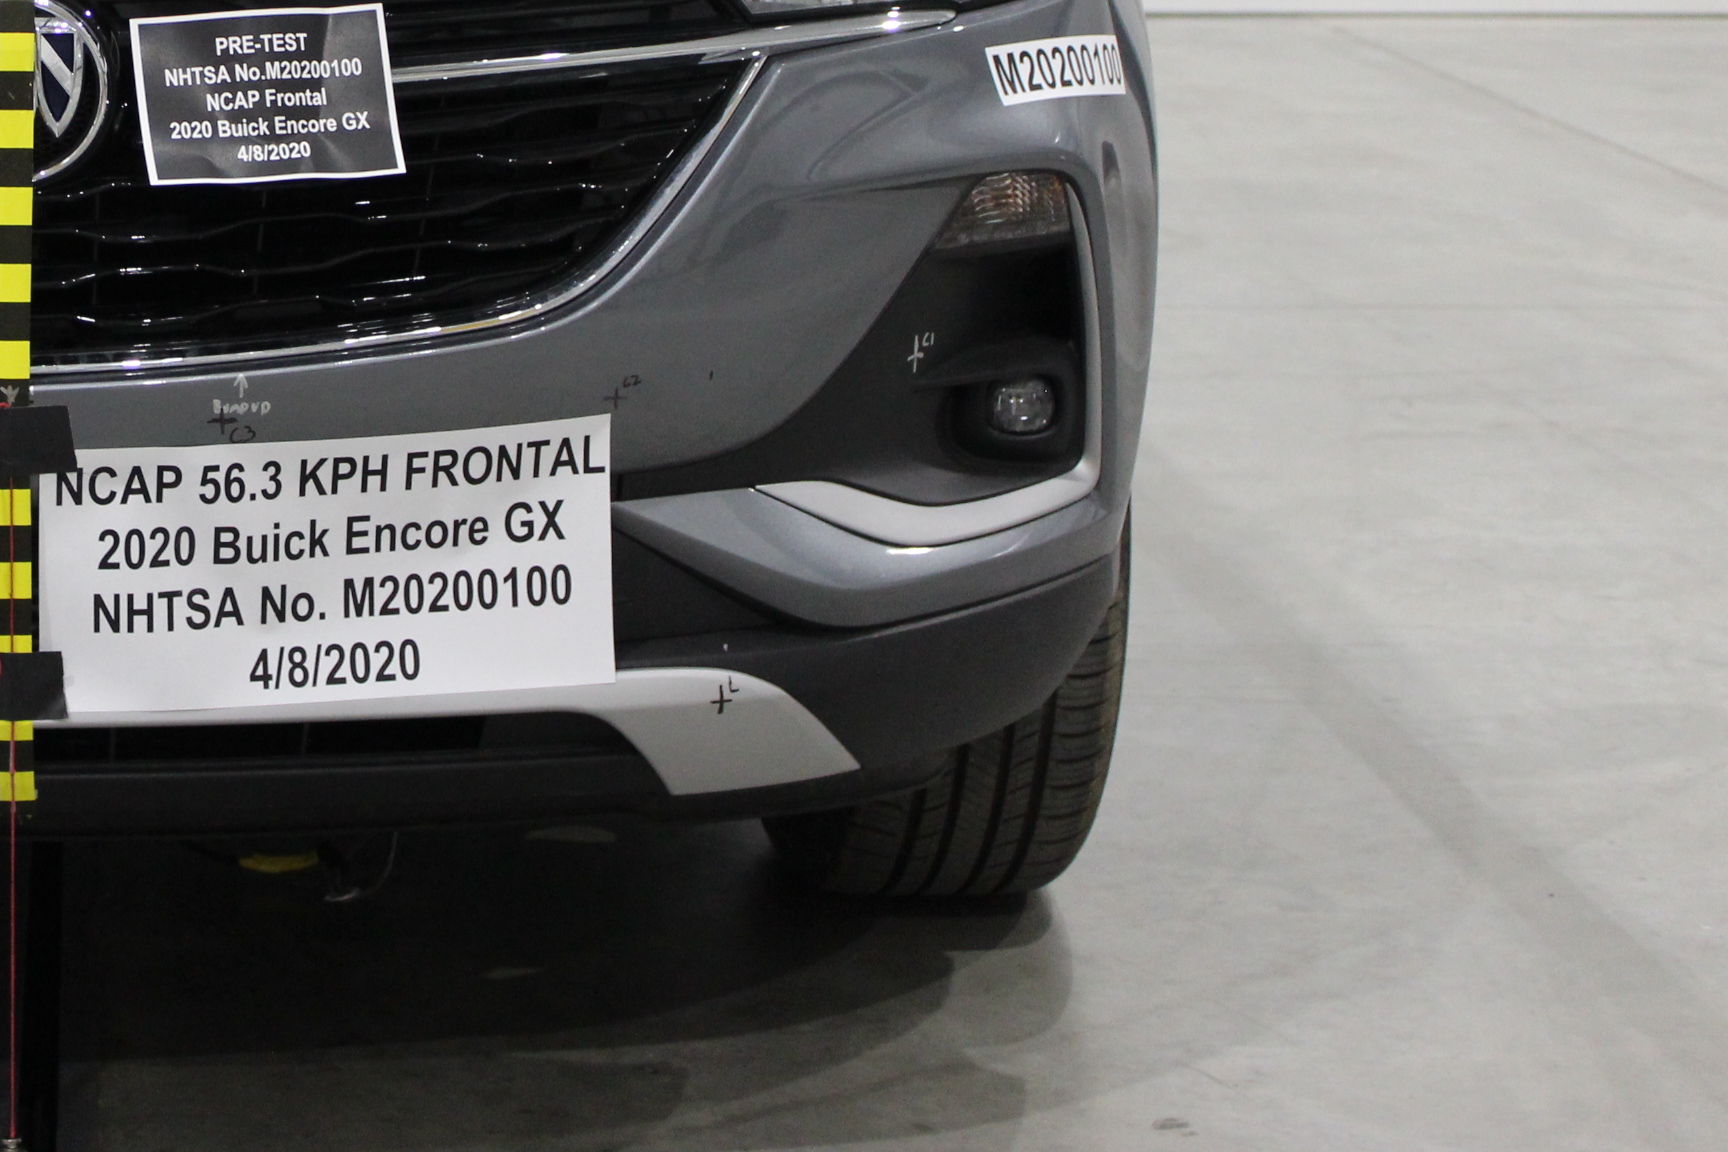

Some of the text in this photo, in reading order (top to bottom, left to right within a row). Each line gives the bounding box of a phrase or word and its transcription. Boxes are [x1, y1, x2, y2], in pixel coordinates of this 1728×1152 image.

[215, 33, 307, 56] PRE-TEST
[164, 65, 231, 87] NHTSA
[992, 43, 1122, 96] M20200100
[206, 87, 327, 112] NCAP Frontal
[169, 111, 370, 139] 2020 Buick Encore GX
[237, 141, 311, 162] 4/8/2020
[55, 434, 606, 507] NCAP 56.3 KPH FRONTAL
[97, 500, 566, 570] 2020 Buick Encore GX
[93, 563, 572, 635] NHTSA No. M20200100
[249, 639, 421, 691] 4/8/2020
